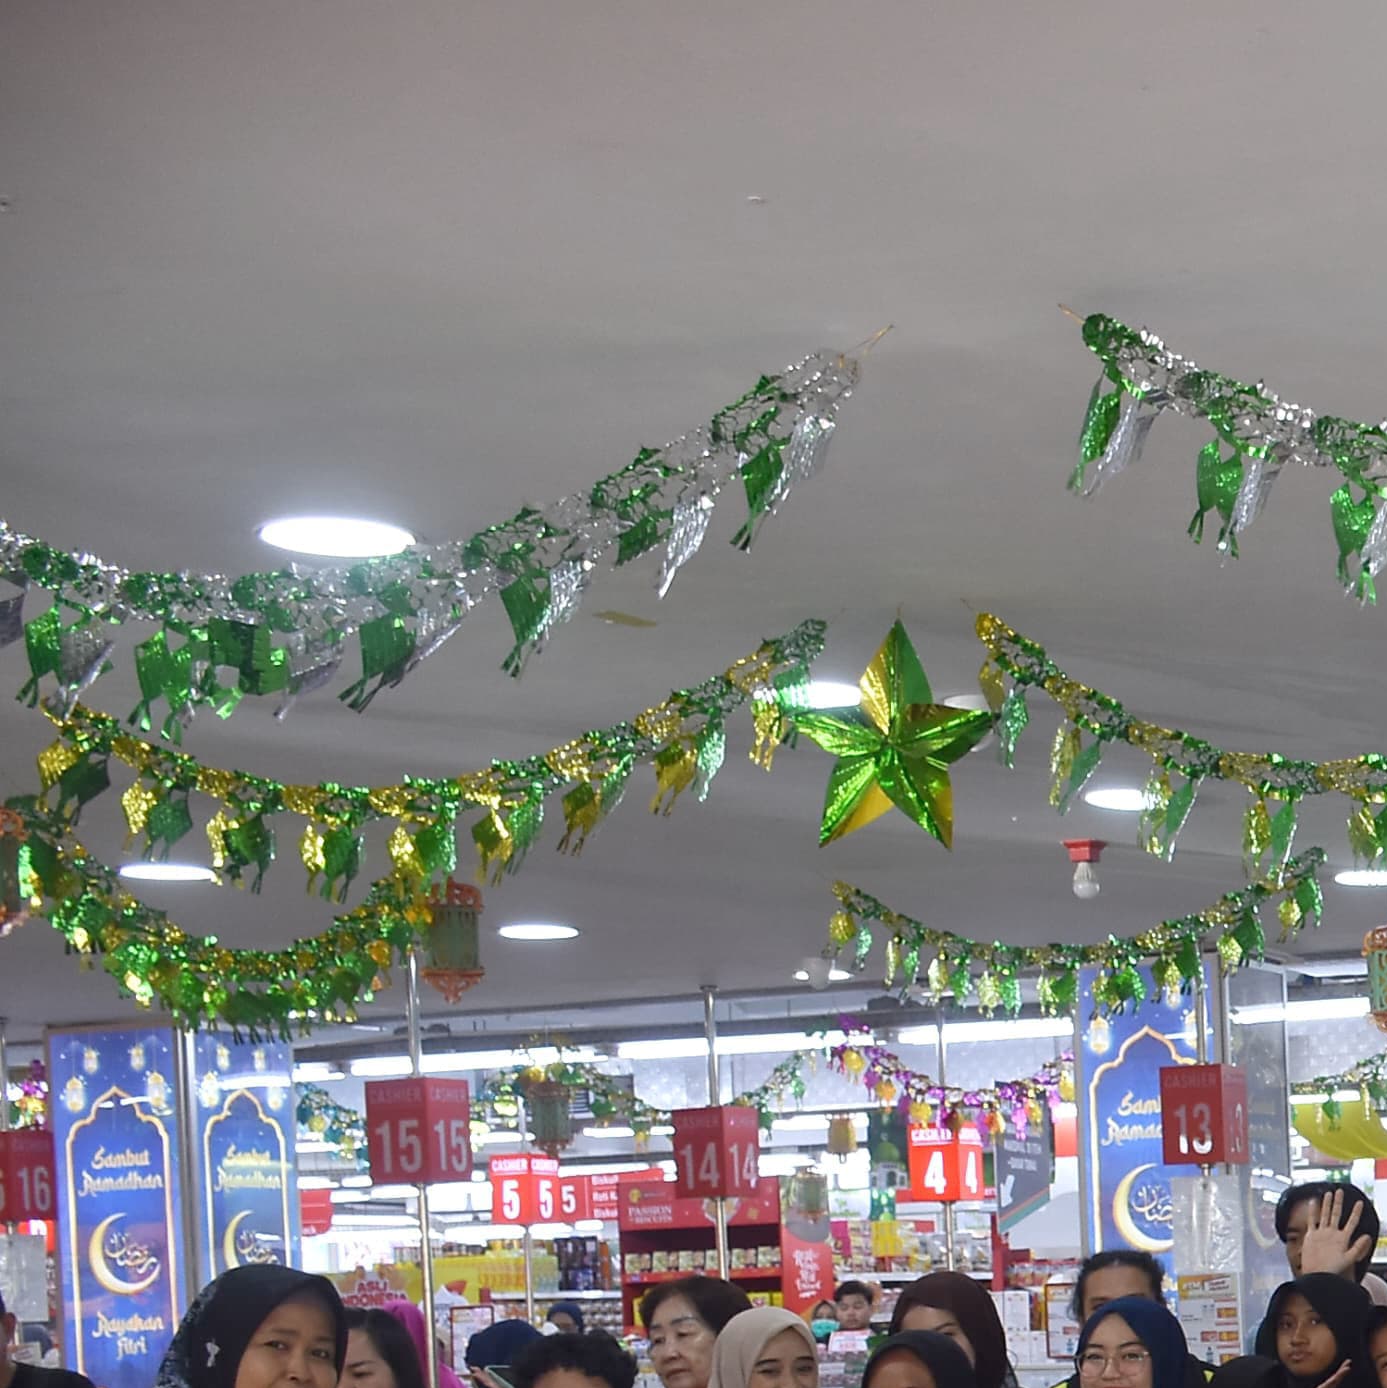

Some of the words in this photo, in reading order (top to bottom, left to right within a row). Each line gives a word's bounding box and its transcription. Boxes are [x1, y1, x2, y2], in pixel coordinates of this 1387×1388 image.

[374, 1118, 422, 1174] 15
[433, 1118, 468, 1173] 15
[1173, 1102, 1214, 1155] 13
[90, 1145, 150, 1170] Sambut
[222, 1143, 271, 1167] Sambut
[491, 1158, 528, 1173] CASHIER
[679, 1141, 720, 1190] 14
[727, 1142, 758, 1190] 14
[923, 1150, 948, 1195] 4
[964, 1150, 978, 1194] 4
[17, 1165, 50, 1212] 16
[77, 1170, 164, 1198] Ramadhan
[214, 1165, 282, 1192] Ramadhan
[501, 1178, 521, 1220] 5
[560, 1184, 577, 1214] 5
[538, 1179, 553, 1220] 5
[341, 1293, 408, 1307] NDONESIA
[356, 1280, 389, 1293] ASLI
